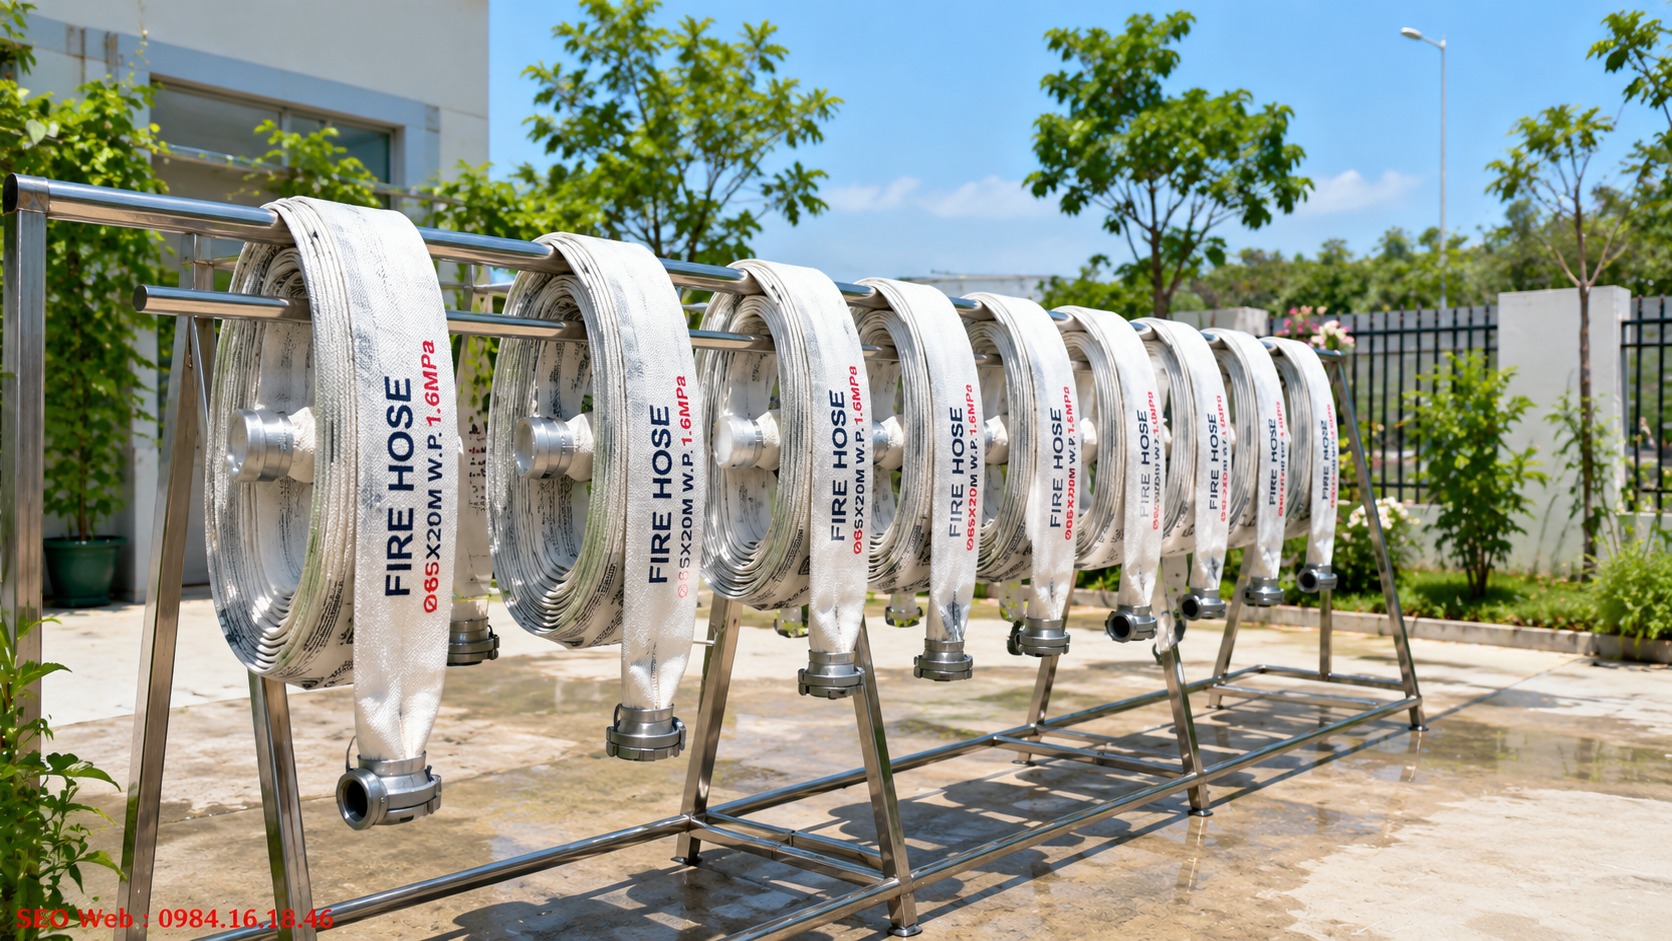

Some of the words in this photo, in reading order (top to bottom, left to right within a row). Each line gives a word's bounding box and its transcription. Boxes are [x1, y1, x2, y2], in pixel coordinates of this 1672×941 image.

[421, 340, 442, 426] 1.6MPa
[676, 375, 693, 446] 1.6MPa
[965, 384, 977, 436] 1.6MPa
[384, 376, 414, 491] HOSE
[427, 432, 443, 482] W.P.
[650, 405, 672, 499] HOSE
[829, 390, 848, 469] HOSE
[855, 427, 865, 465] W.P.
[950, 407, 965, 474] HOSE
[970, 438, 978, 470] W.P.
[1050, 407, 1064, 470] HOSE
[1137, 409, 1150, 465] HOSE
[1207, 413, 1219, 462] HOSE
[681, 450, 694, 493] W.P.
[1140, 473, 1150, 518] FIRE
[1209, 469, 1219, 510] FIRE
[1269, 469, 1277, 506] FIRE
[831, 480, 848, 541] FIRE
[949, 483, 964, 537] FIRE
[1050, 477, 1063, 528] FIRE
[385, 507, 414, 596] FIRE
[649, 512, 672, 583] FIRE
